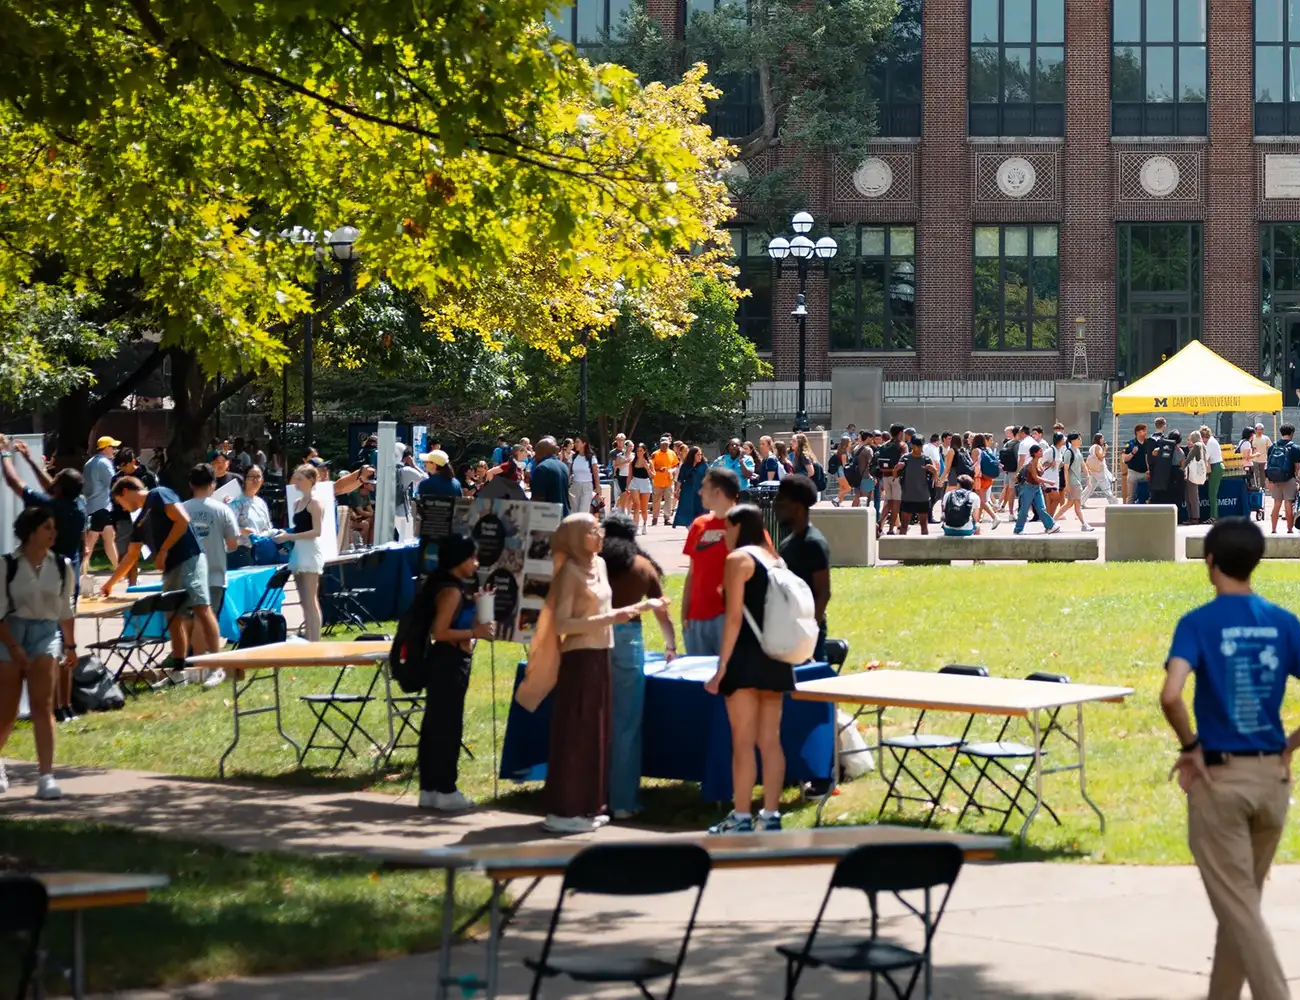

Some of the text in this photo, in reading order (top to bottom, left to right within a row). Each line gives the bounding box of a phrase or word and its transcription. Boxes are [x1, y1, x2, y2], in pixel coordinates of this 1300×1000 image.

[1154, 396, 1241, 408] M CAMPUS INVOLVEMENT
